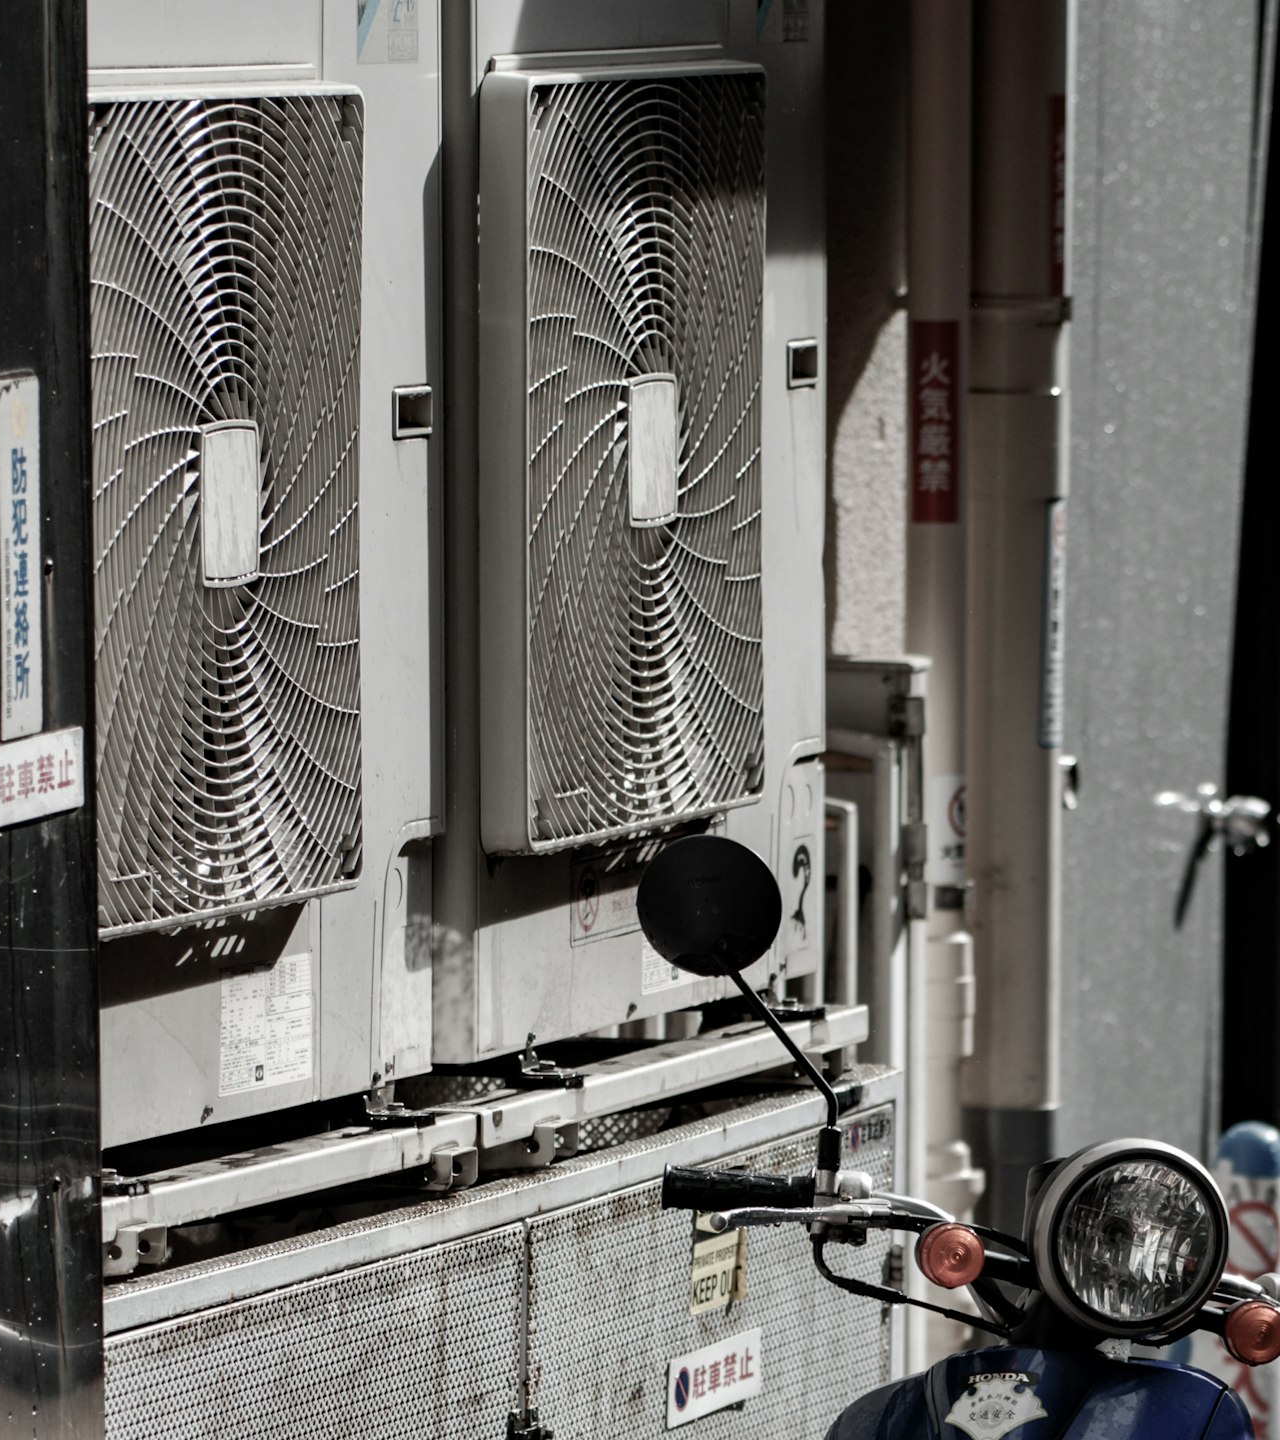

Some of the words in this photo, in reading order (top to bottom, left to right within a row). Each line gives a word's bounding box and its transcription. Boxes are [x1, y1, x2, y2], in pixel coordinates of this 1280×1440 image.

[11, 446, 30, 701] 防犯連絡所
[693, 1273, 718, 1305] KEEP
[692, 1347, 754, 1399] 駐車禁止
[968, 1372, 1030, 1385] HONDA
